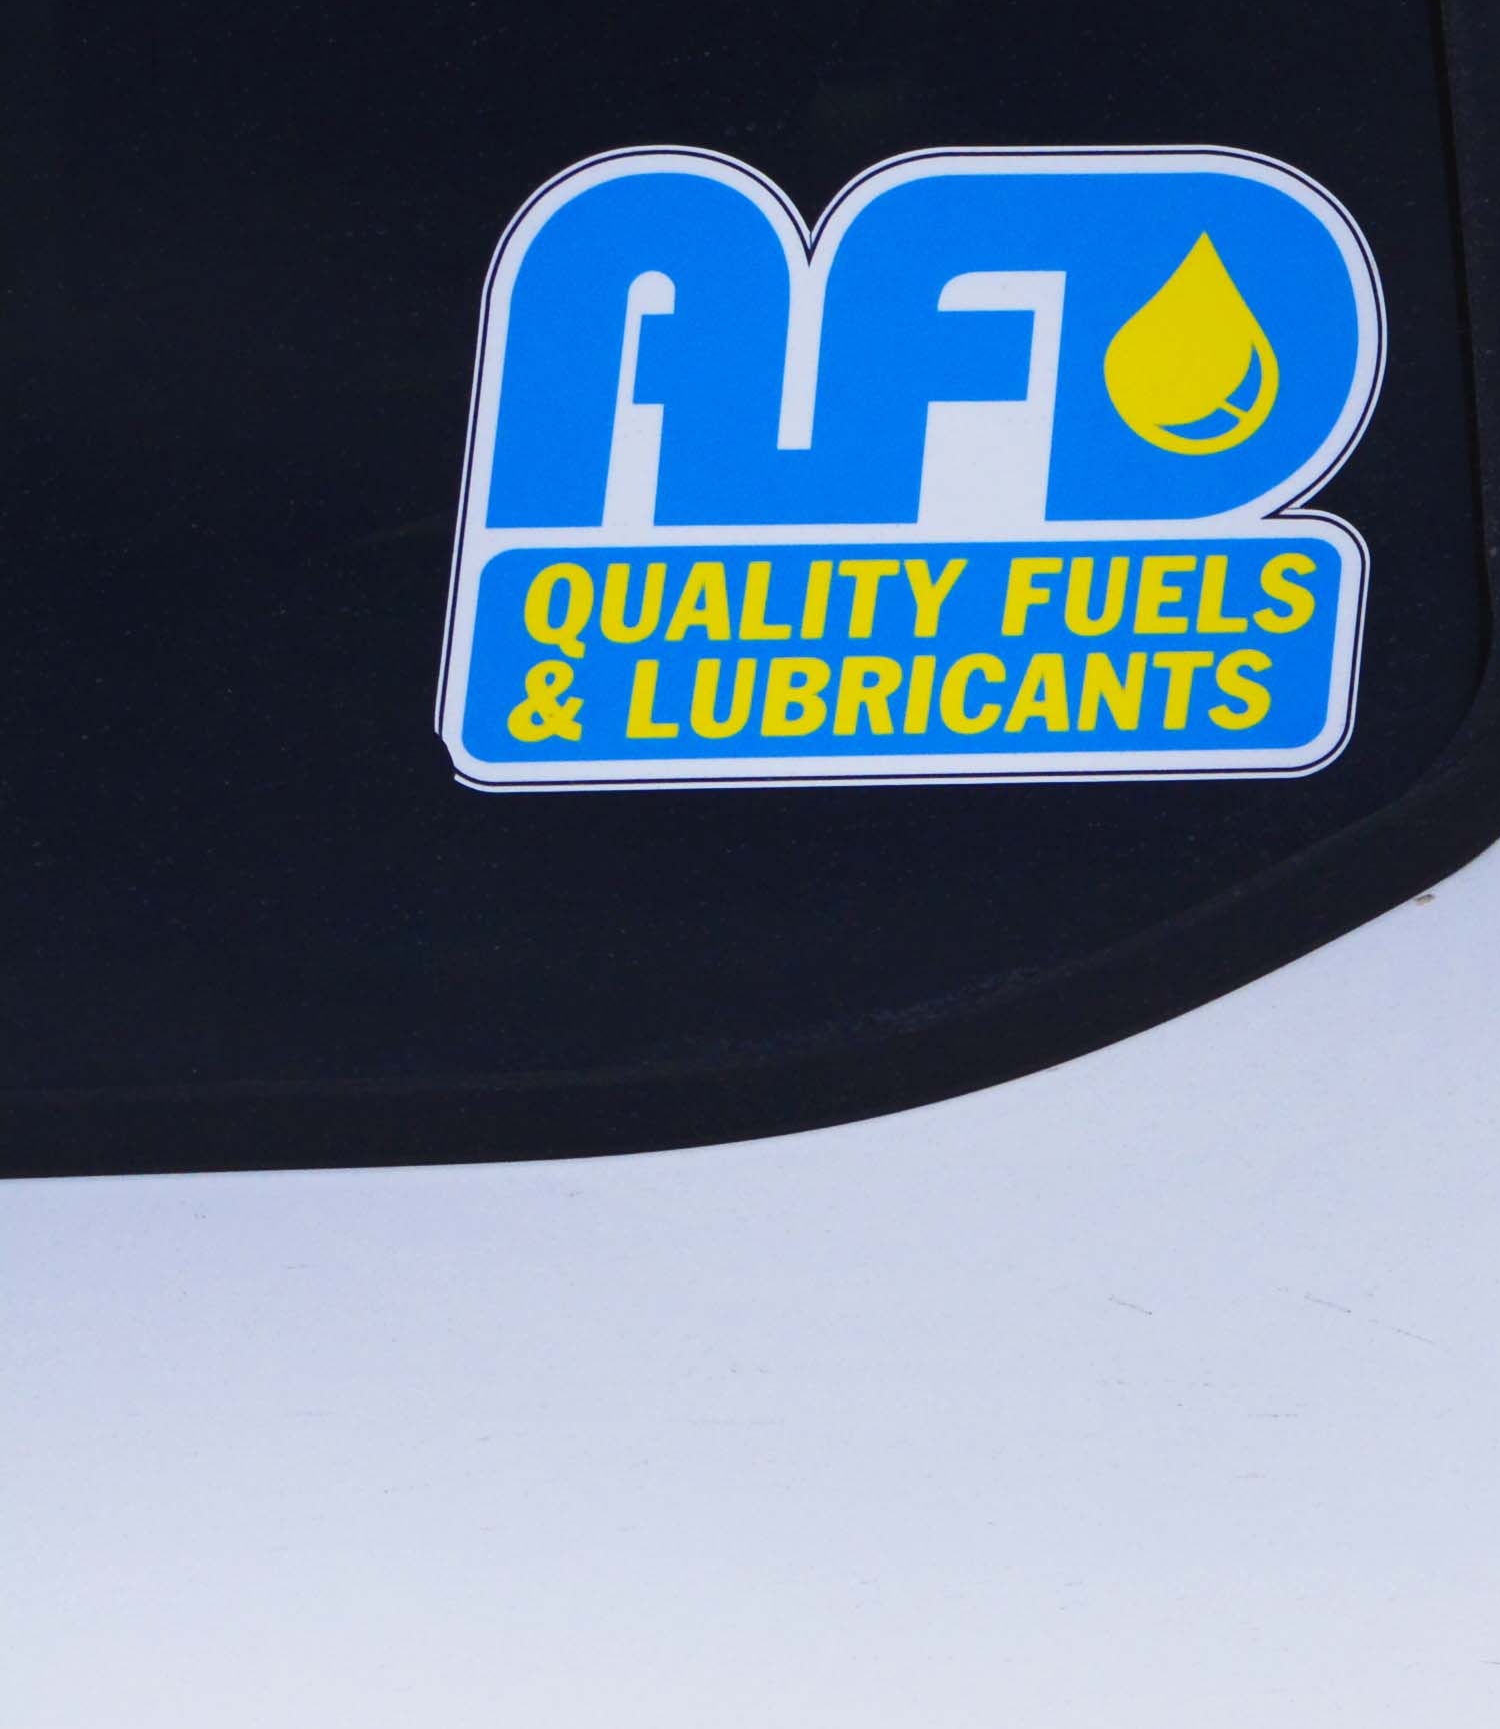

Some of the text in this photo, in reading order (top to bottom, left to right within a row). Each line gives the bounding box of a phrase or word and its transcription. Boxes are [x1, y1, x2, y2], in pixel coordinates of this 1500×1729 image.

[486, 172, 1359, 529] AFD
[525, 554, 1316, 659] QUALITY FUELS
[508, 650, 1272, 742] & LUBRICANTS
